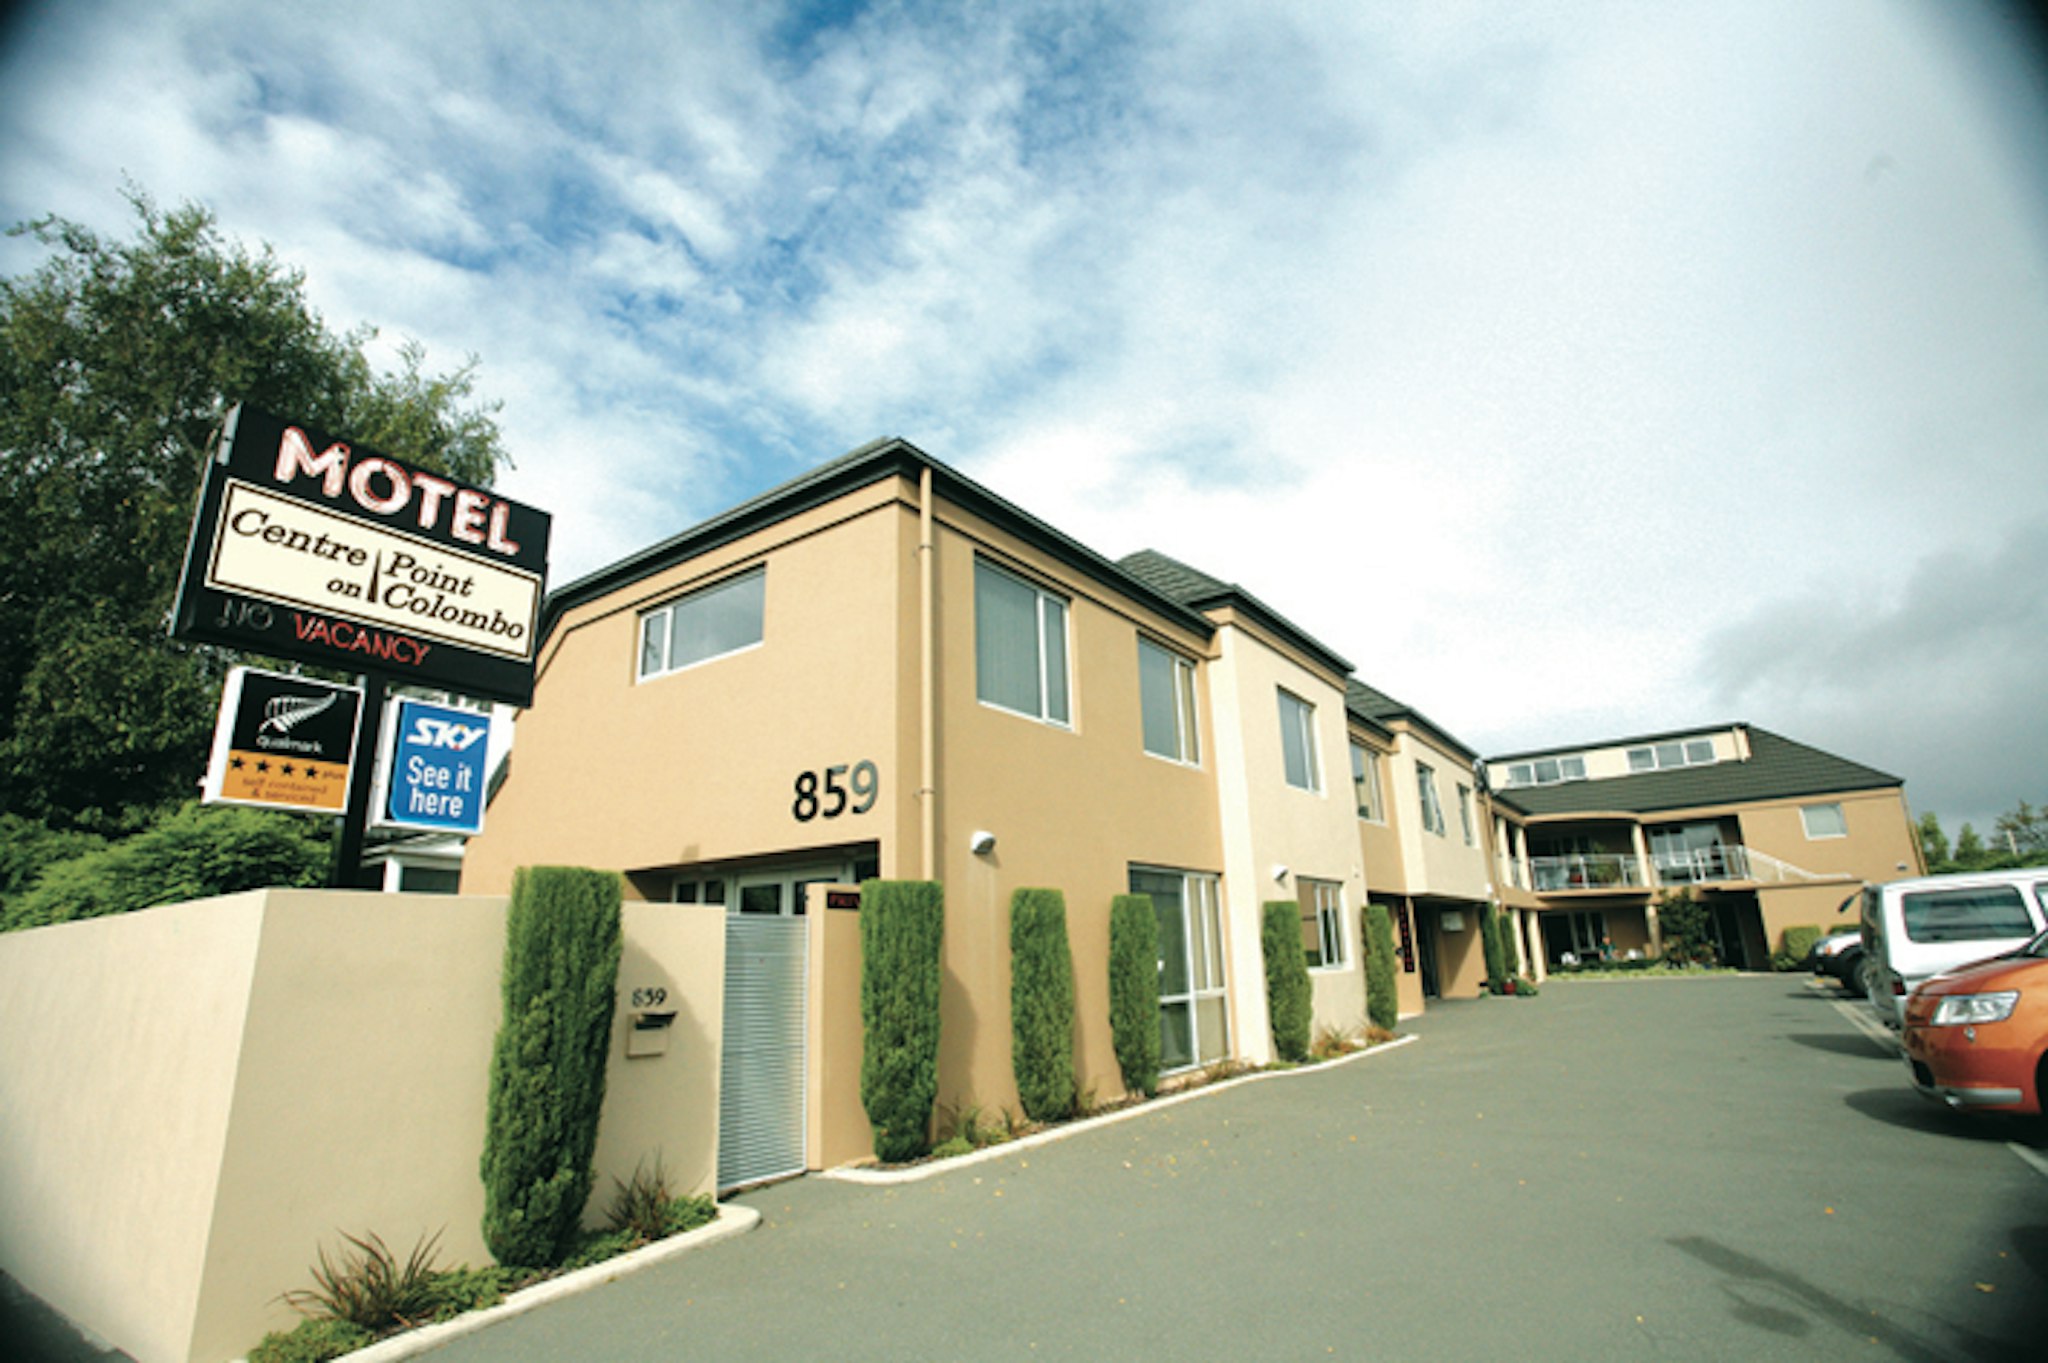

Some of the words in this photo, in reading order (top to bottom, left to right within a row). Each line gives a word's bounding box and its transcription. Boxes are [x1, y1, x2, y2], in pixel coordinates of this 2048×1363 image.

[274, 426, 520, 557] MOTEL
[231, 508, 368, 567] Centre
[384, 550, 475, 598] Point
[215, 599, 274, 631] NO
[293, 612, 431, 666] VACANCY
[326, 575, 362, 598] on
[382, 582, 524, 640] Colombo
[406, 718, 486, 751] SKY
[406, 755, 450, 789] See
[455, 761, 472, 792] it
[409, 787, 464, 818] here
[793, 759, 879, 823] 859
[632, 987, 667, 1008] 859
